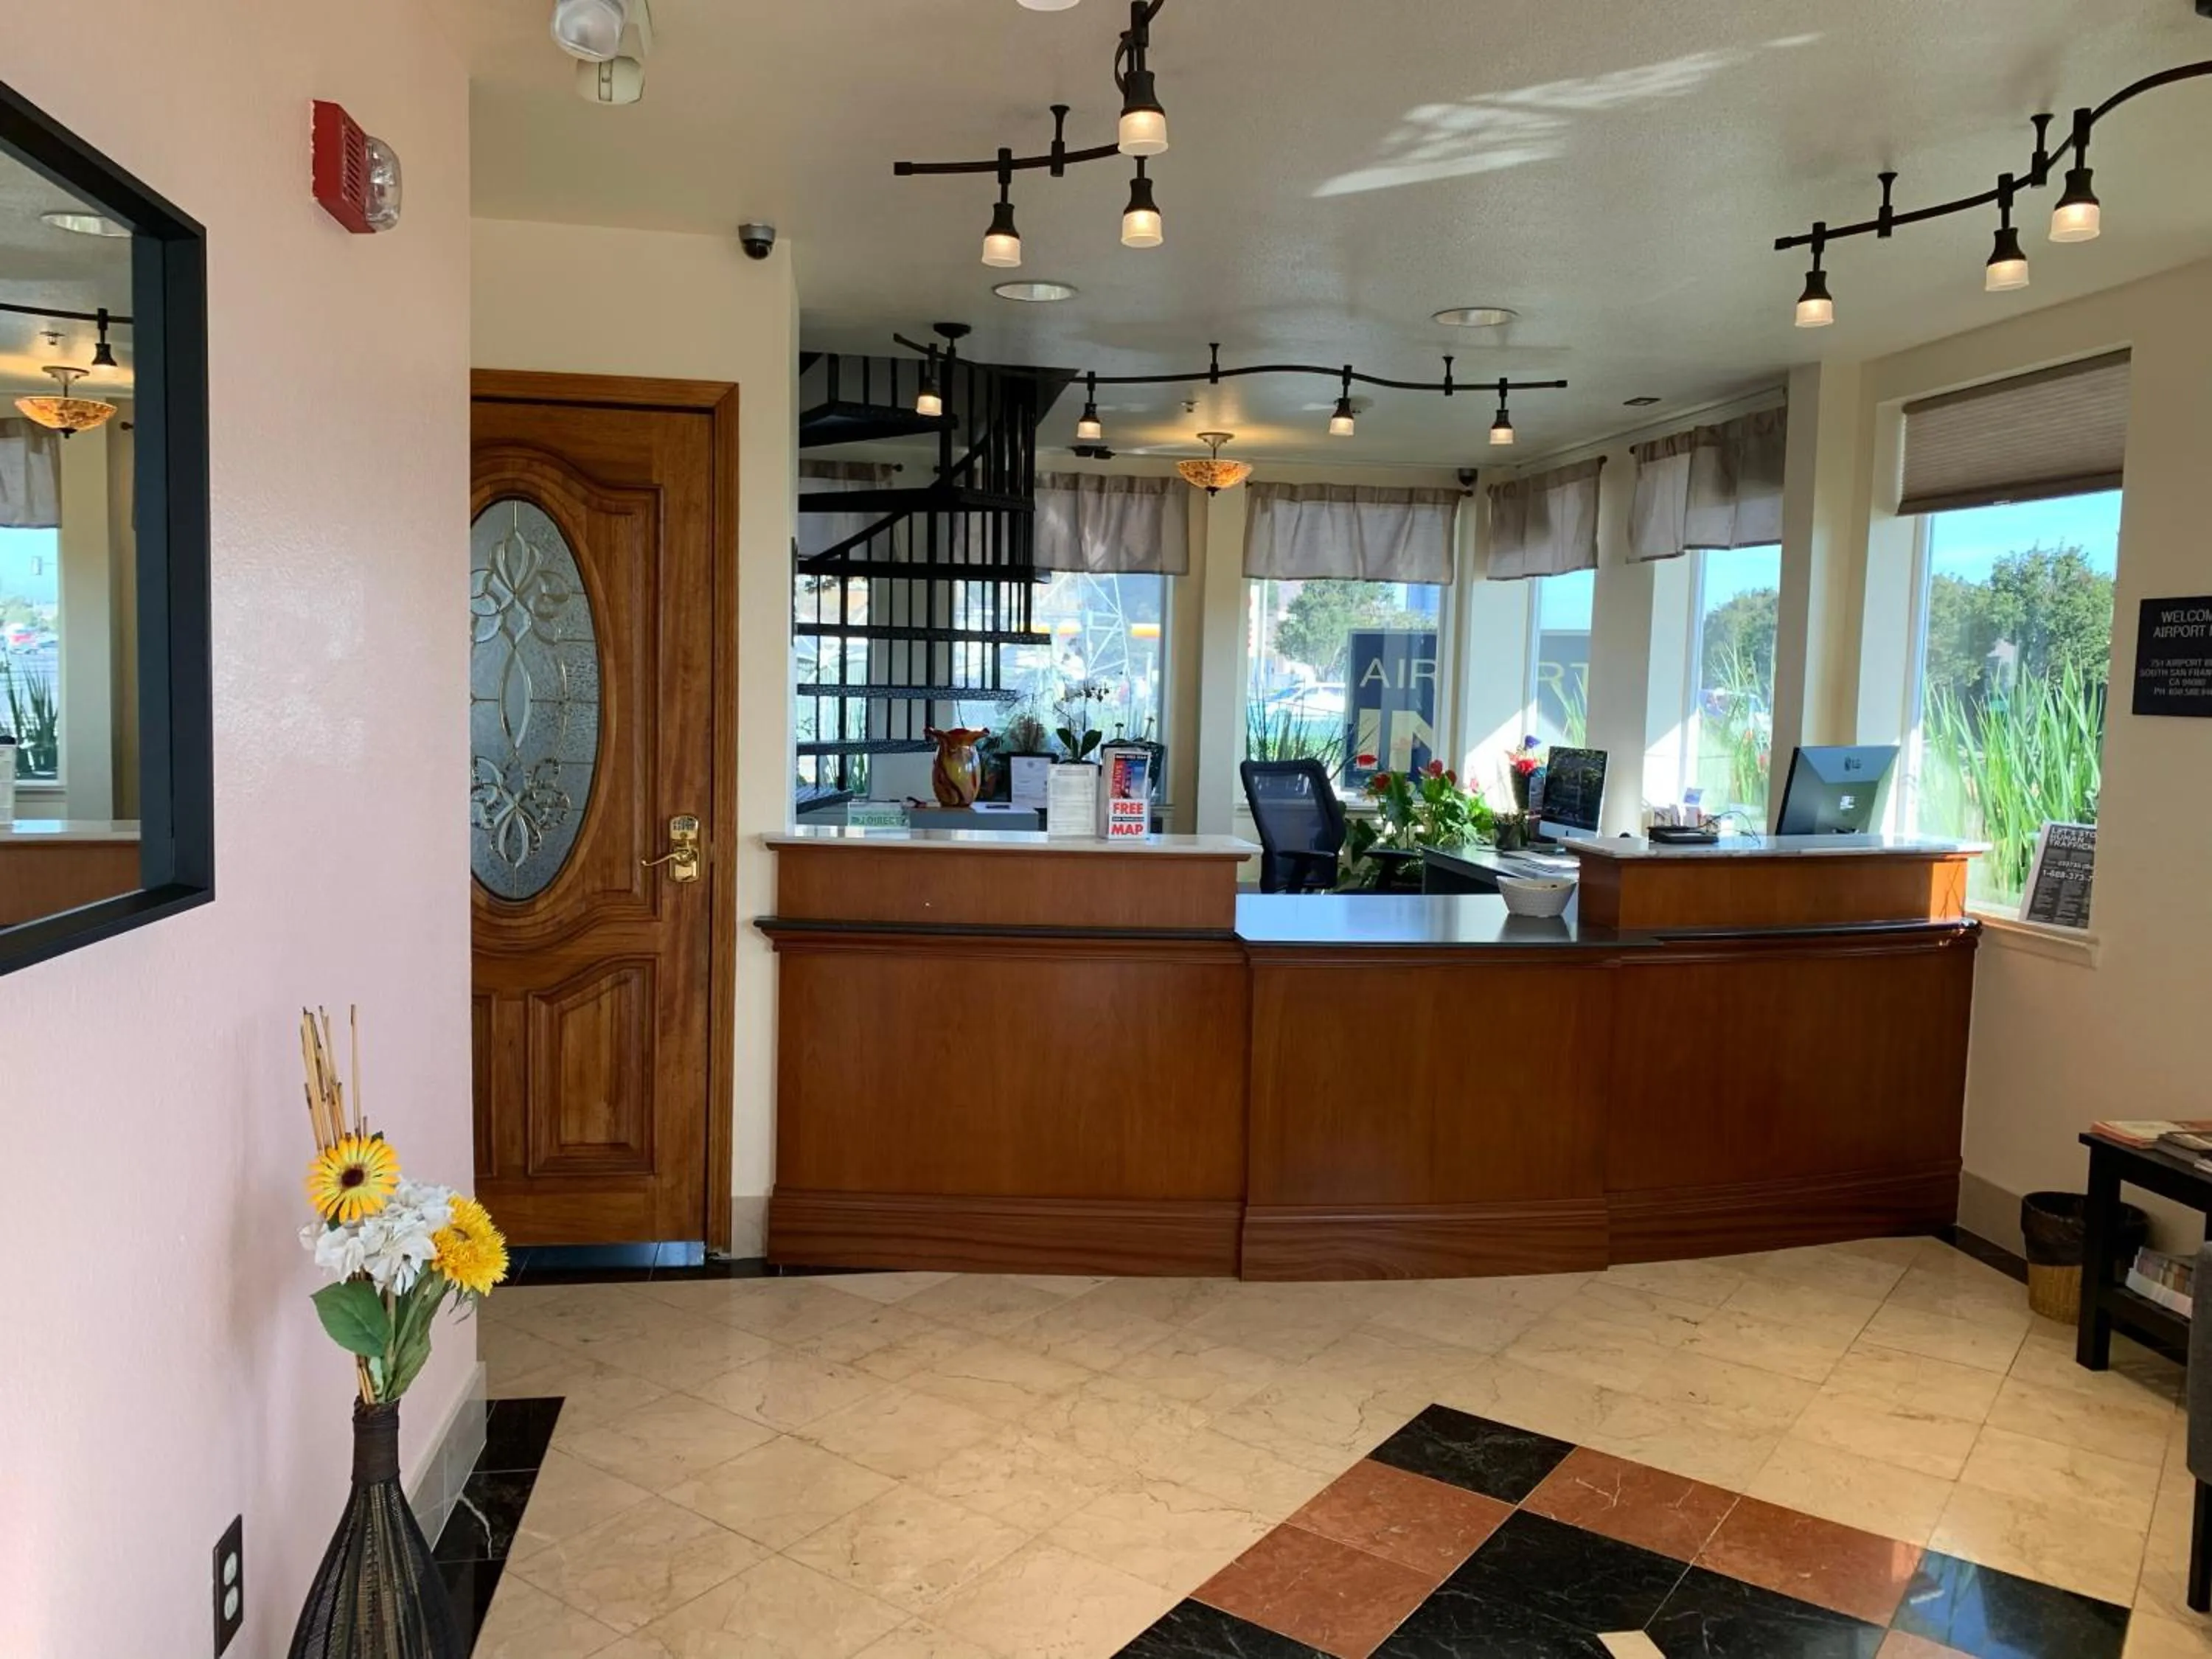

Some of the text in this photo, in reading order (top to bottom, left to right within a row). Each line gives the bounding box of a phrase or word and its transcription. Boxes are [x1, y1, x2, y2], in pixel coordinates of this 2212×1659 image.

[2161, 609, 2212, 623] WELCOM
[2153, 625, 2206, 638] AIRPORT
[1113, 803, 1144, 815] FREE
[1111, 824, 1144, 835] MAP
[2079, 830, 2096, 838] STO
